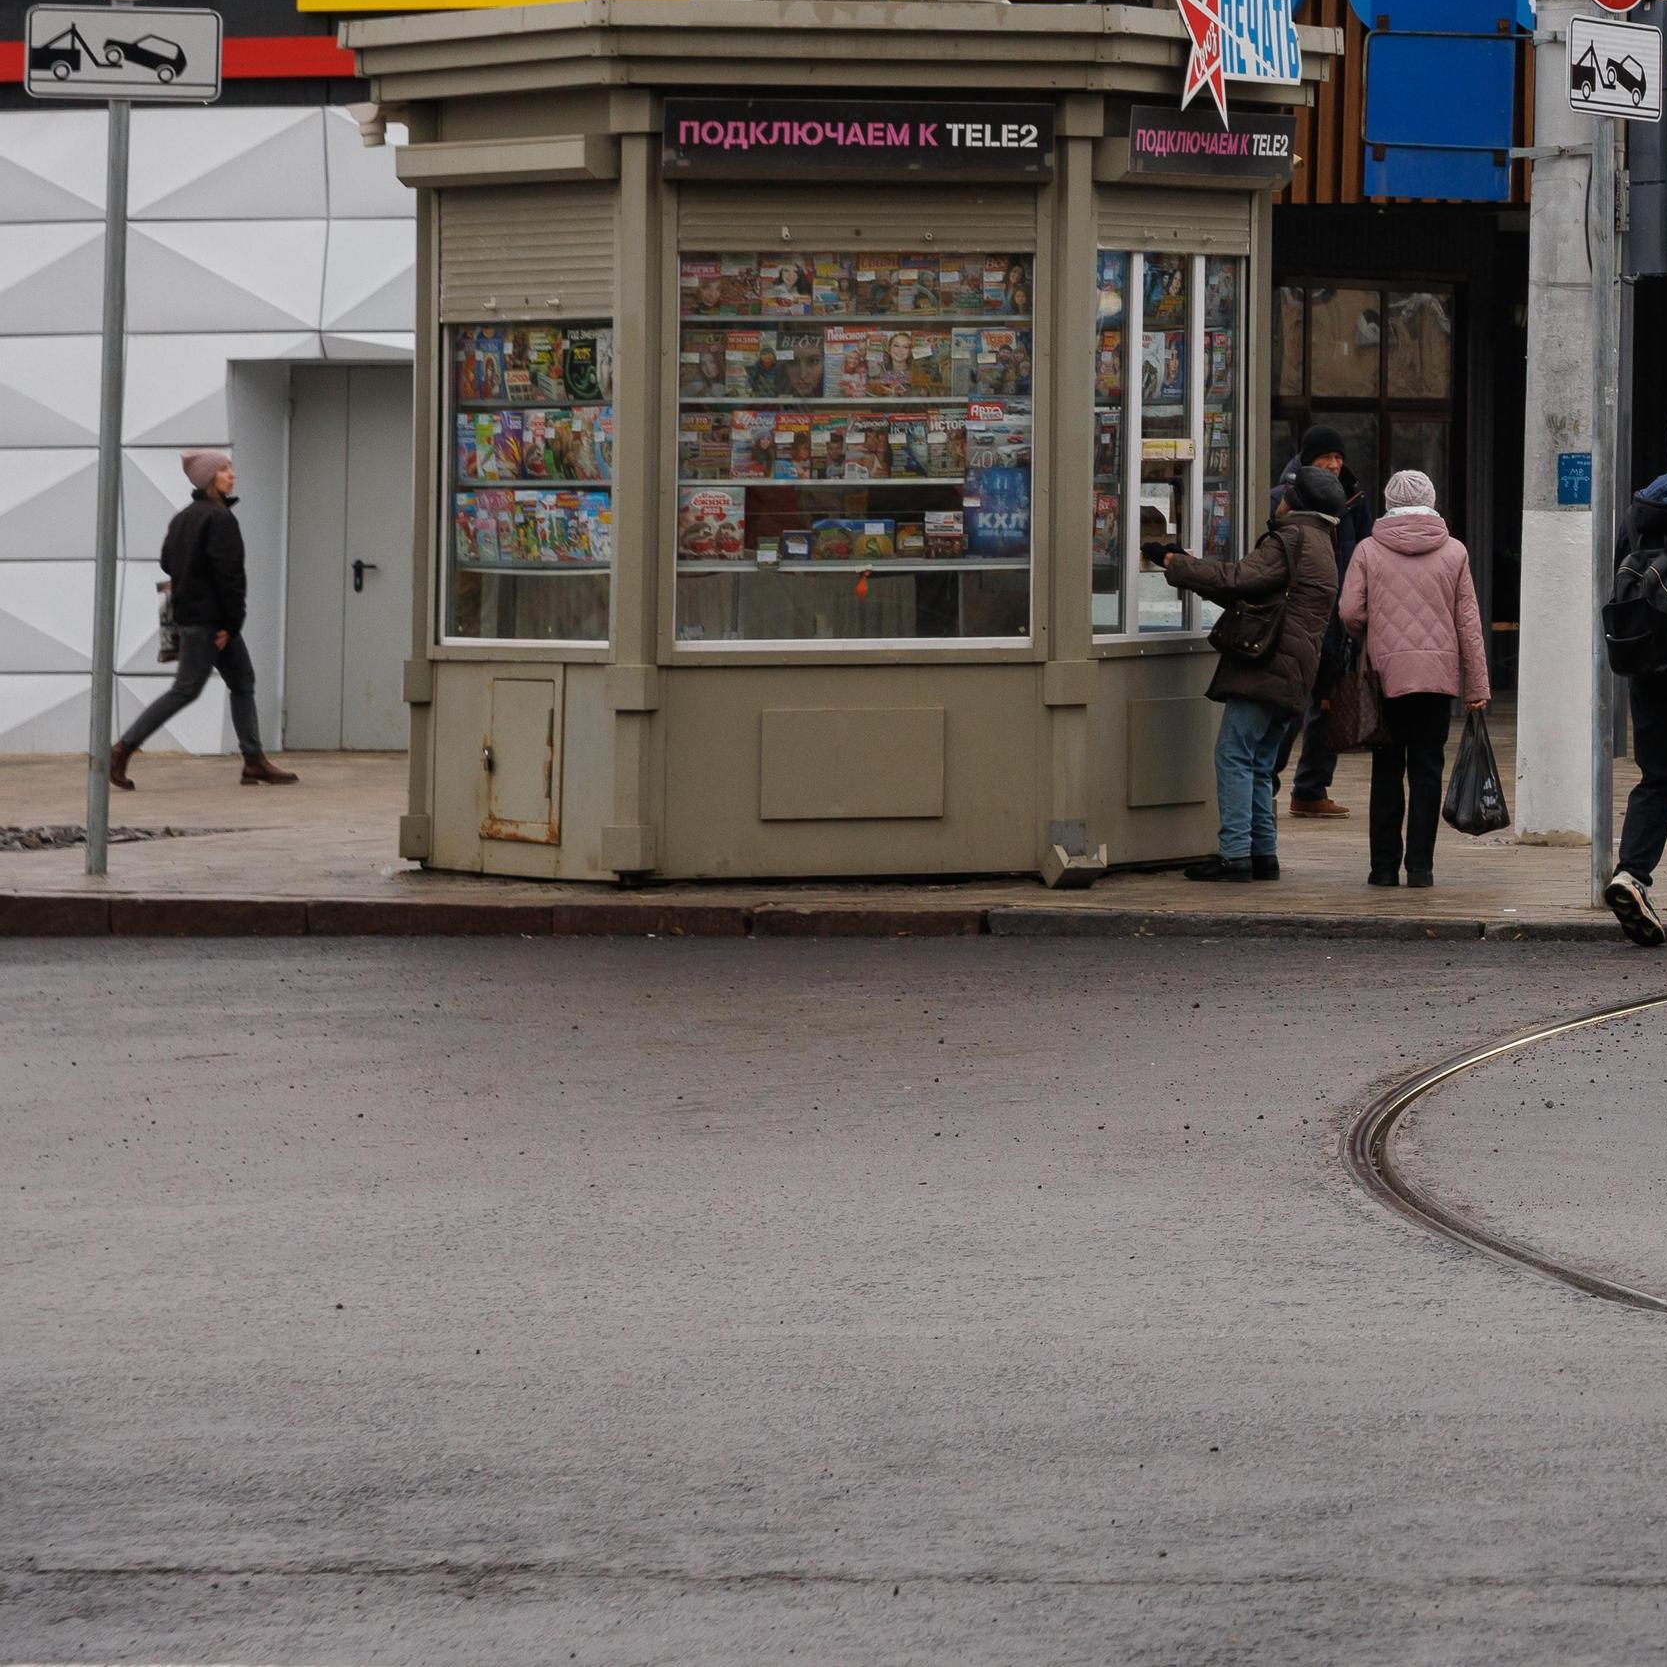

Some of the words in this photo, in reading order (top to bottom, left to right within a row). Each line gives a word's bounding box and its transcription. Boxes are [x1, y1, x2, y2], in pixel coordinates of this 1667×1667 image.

[678, 120, 910, 150] ПОДКЛЮЧАЕМ
[918, 123, 938, 147] К
[946, 123, 1039, 148] TELE2
[1136, 128, 1239, 157] ПОДКЛЮЧАЕМ
[1240, 130, 1250, 156] К
[1252, 134, 1289, 157] TELE2
